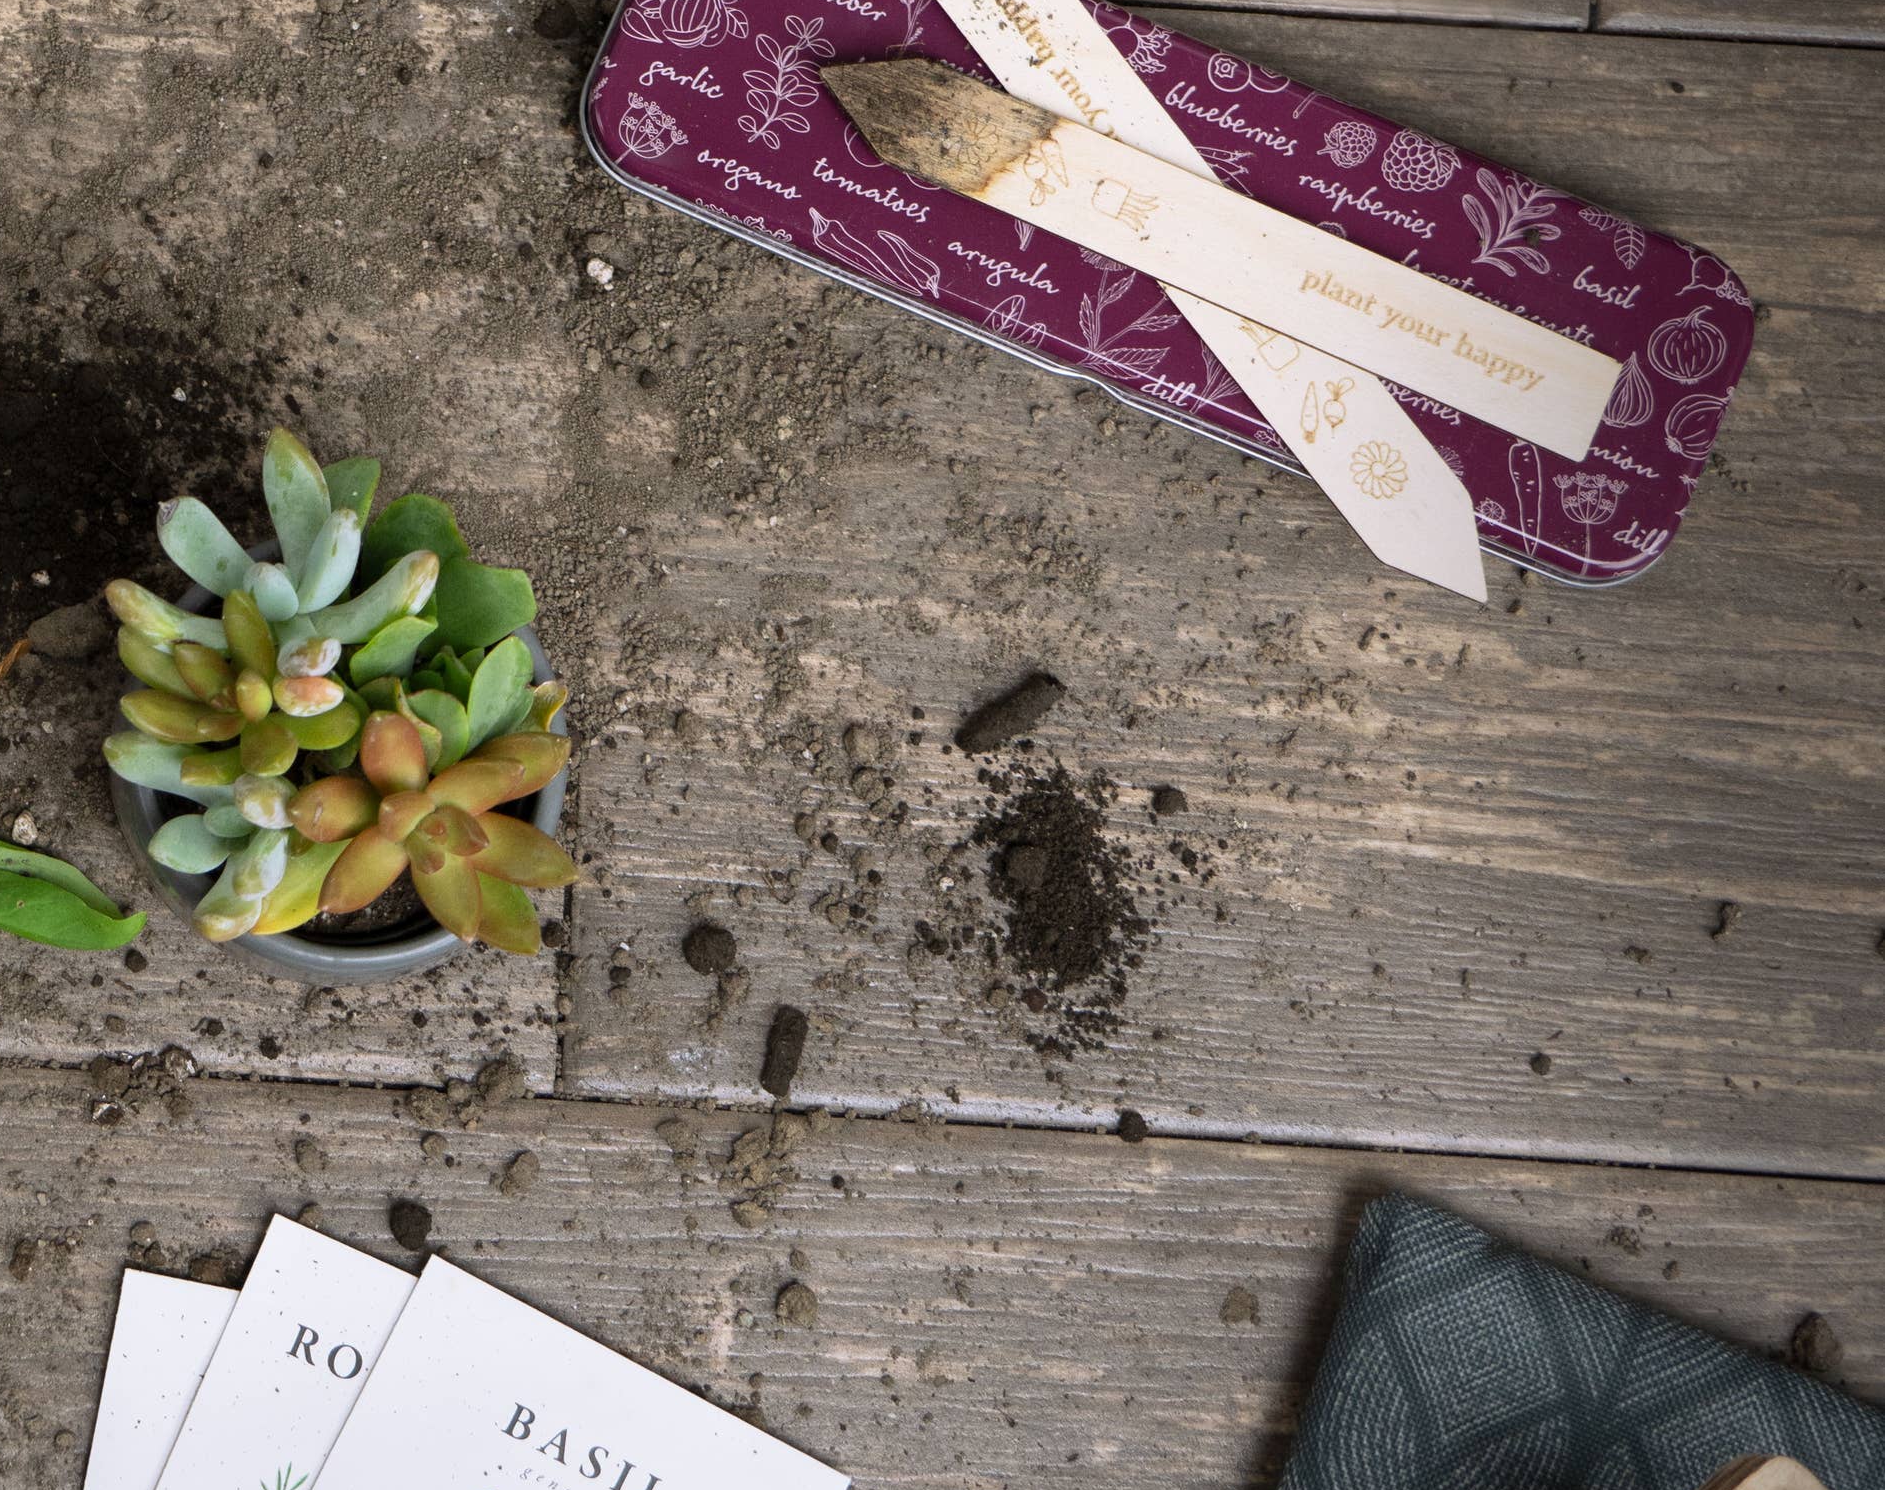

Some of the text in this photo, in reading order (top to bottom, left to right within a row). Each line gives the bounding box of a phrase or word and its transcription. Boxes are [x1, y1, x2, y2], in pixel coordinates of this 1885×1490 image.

[638, 60, 724, 99] garlic
[1048, 67, 1108, 127] your
[1165, 81, 1298, 157] blueberries
[697, 149, 802, 200] oregano
[812, 157, 931, 223] tomatoes
[1299, 173, 1436, 239] raspberries
[947, 241, 1059, 295] arugula
[1572, 265, 1641, 310] basil
[1298, 269, 1379, 316] plant
[1378, 304, 1450, 348] your
[1452, 332, 1545, 392] happy
[1140, 374, 1196, 407] dill
[1590, 445, 1660, 478] nion
[1613, 520, 1669, 556] dill
[285, 1322, 364, 1380] RO
